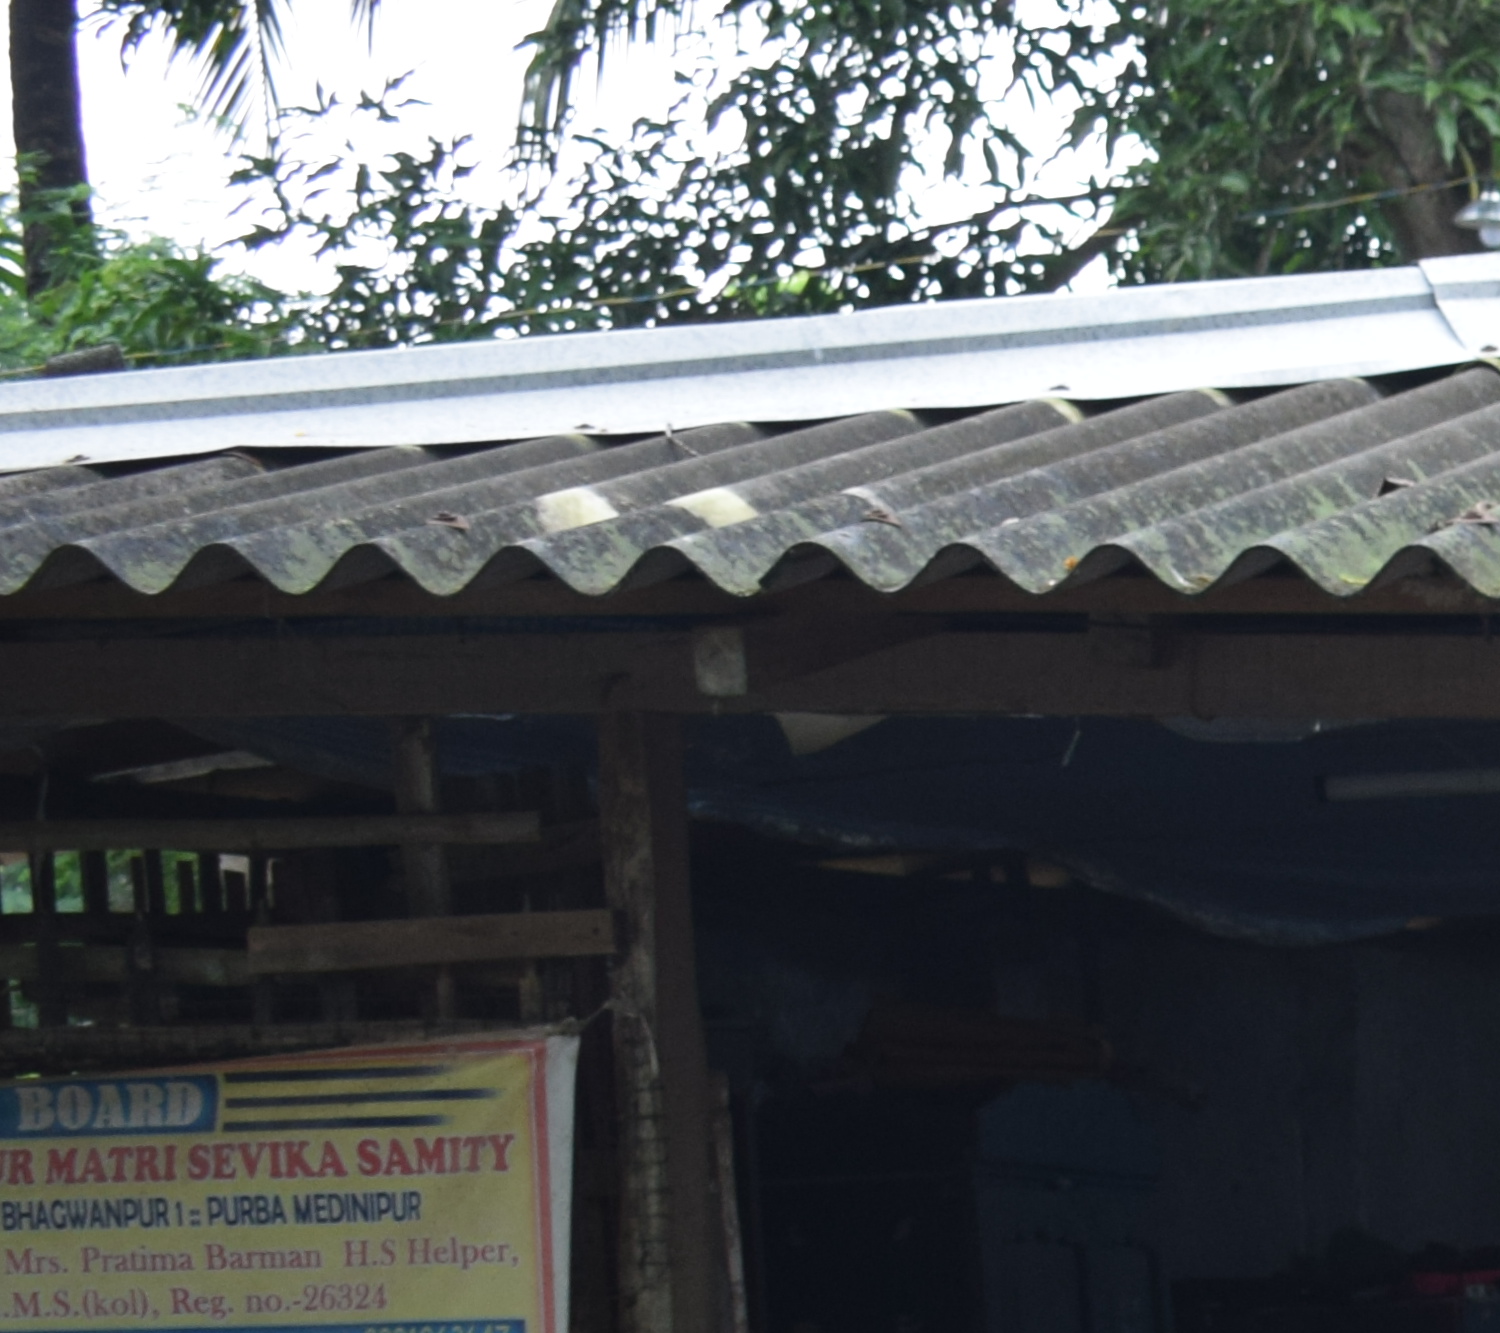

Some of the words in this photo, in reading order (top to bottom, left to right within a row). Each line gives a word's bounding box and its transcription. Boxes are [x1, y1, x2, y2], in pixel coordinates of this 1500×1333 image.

[15, 1082, 203, 1131] BOARD
[46, 1144, 176, 1184] MATRI
[187, 1140, 348, 1181] SEVIKA
[357, 1134, 514, 1176] SAMITY
[3, 1198, 169, 1230] BHAGWANPUR
[207, 1195, 286, 1225] PURBA
[293, 1191, 421, 1224] MEDINIPUR
[5, 1248, 68, 1274] Mrs.
[81, 1246, 194, 1272] Pratima
[205, 1243, 321, 1270] Barman
[344, 1240, 396, 1267] H.S
[408, 1237, 518, 1269] Helper,
[171, 1287, 233, 1319] Reg.
